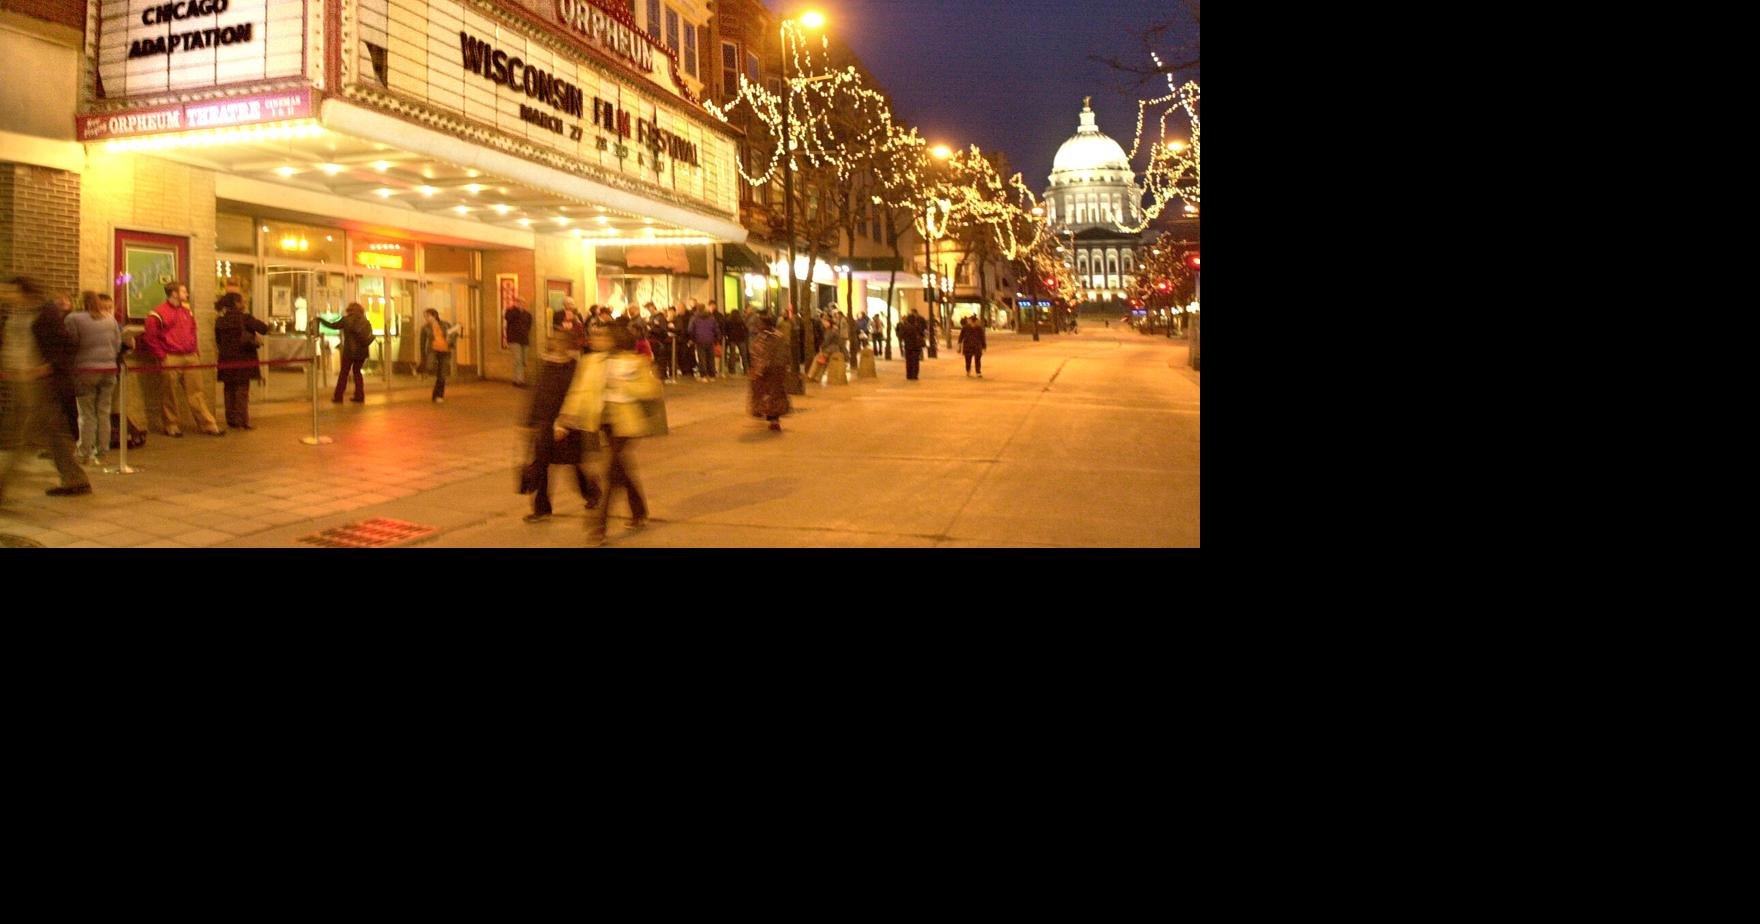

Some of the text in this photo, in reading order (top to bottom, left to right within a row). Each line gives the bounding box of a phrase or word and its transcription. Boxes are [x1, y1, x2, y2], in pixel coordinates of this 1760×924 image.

[142, 0, 229, 26] CHICAGO
[128, 23, 253, 60] ADAPTATION
[559, 0, 653, 73] ORPHEUM
[460, 31, 699, 168] WISCONSIN FILM FESTIVAL
[108, 101, 261, 135] ORPHEUM THEATRE
[520, 103, 563, 135] MARCH
